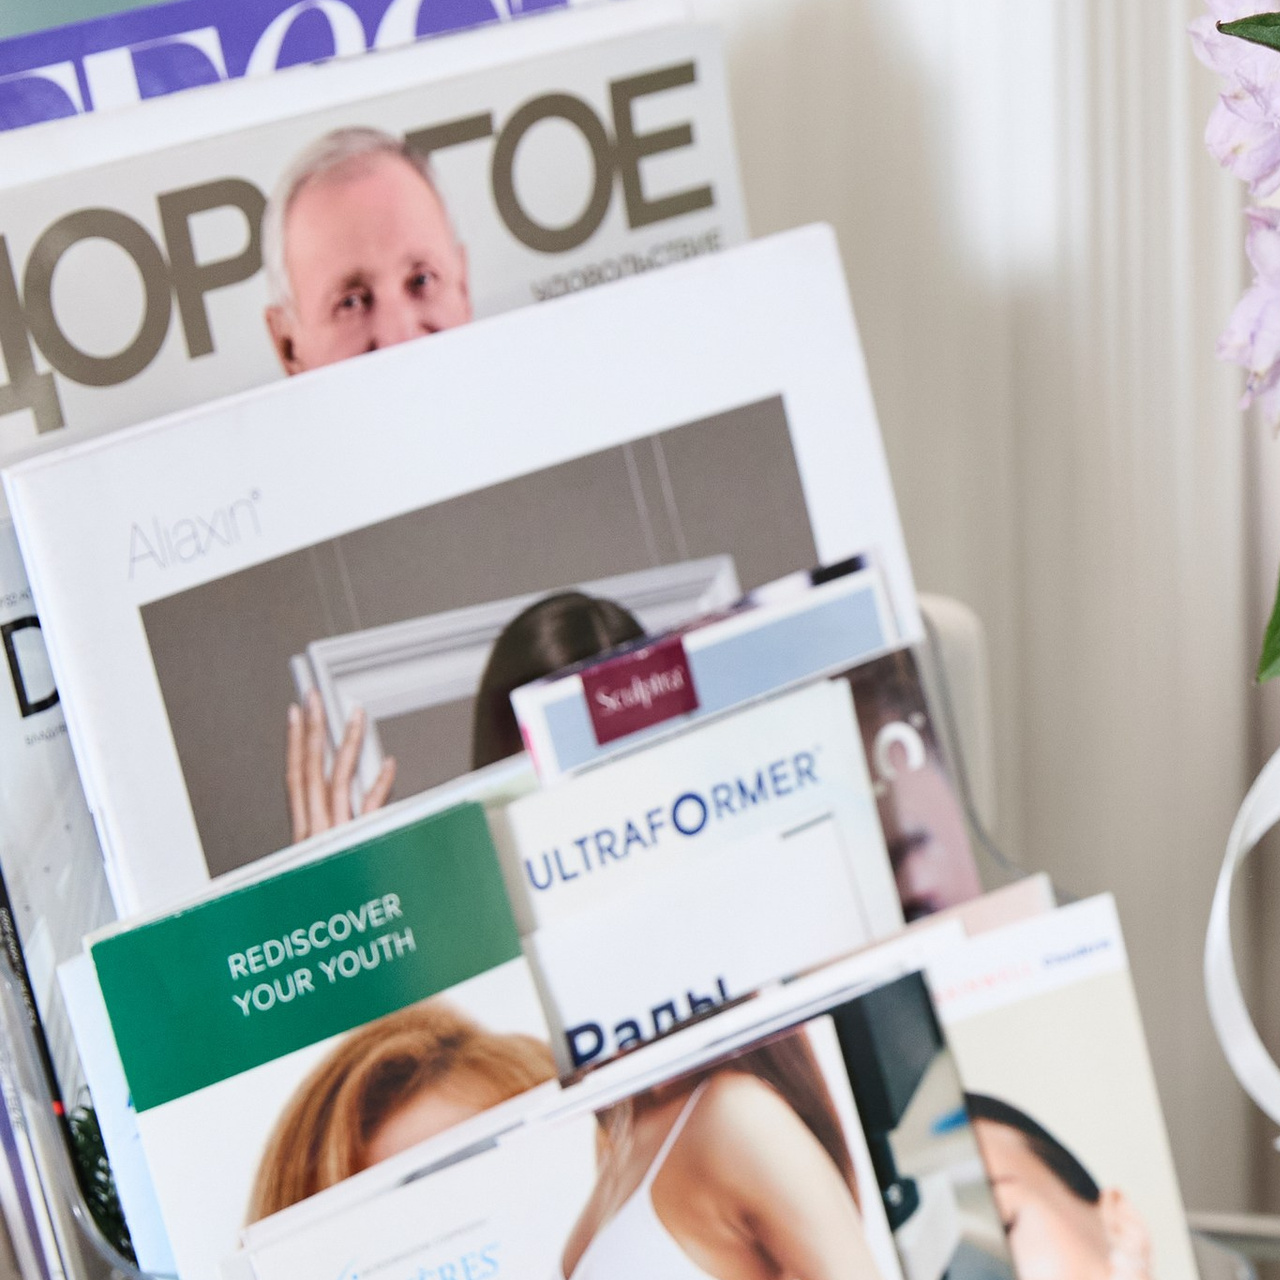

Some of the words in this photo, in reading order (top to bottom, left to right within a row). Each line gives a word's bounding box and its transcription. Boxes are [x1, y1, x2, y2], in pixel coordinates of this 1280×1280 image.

[525, 751, 819, 891] ULTRAFORMER
[228, 893, 402, 980] REDISCOVER
[232, 968, 316, 1017] YOUR
[318, 926, 417, 984] YOUTH
